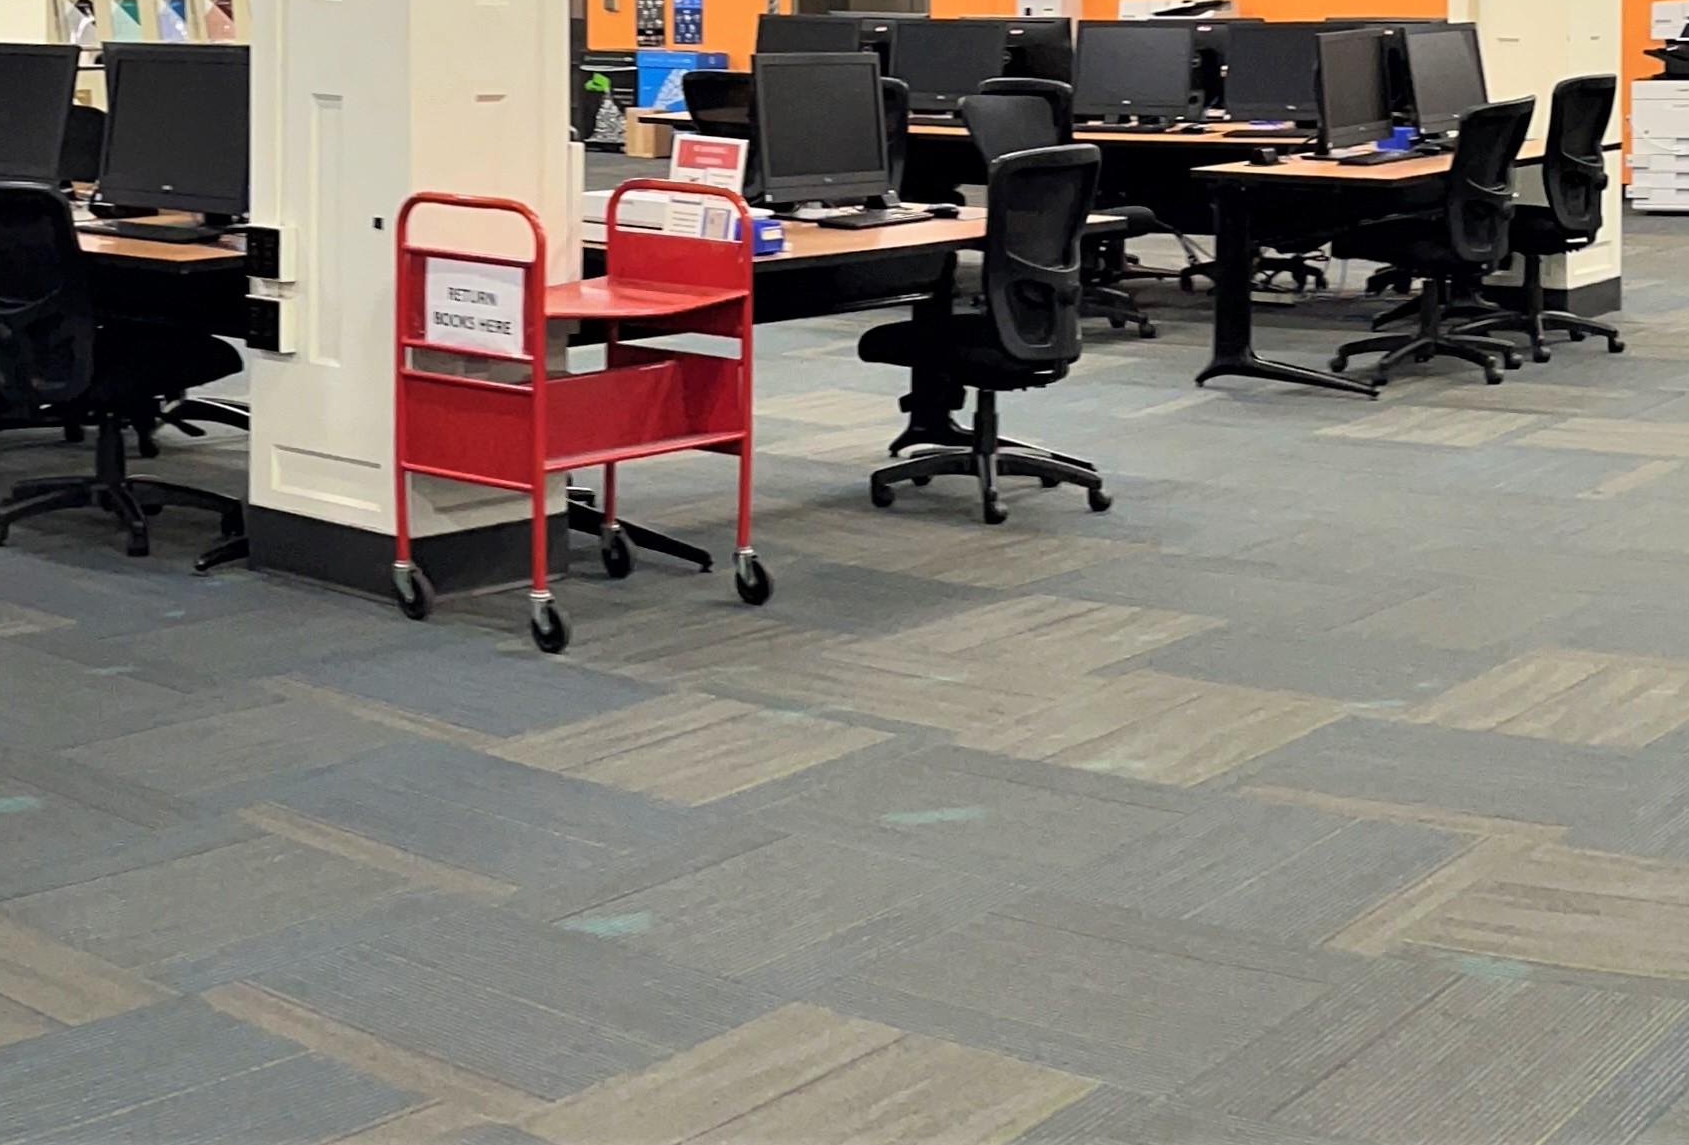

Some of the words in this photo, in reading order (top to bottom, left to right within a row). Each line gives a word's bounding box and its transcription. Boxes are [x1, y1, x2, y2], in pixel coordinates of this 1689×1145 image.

[447, 286, 499, 307] RETURN
[433, 310, 476, 331] BOOKS
[478, 318, 513, 336] HERE
